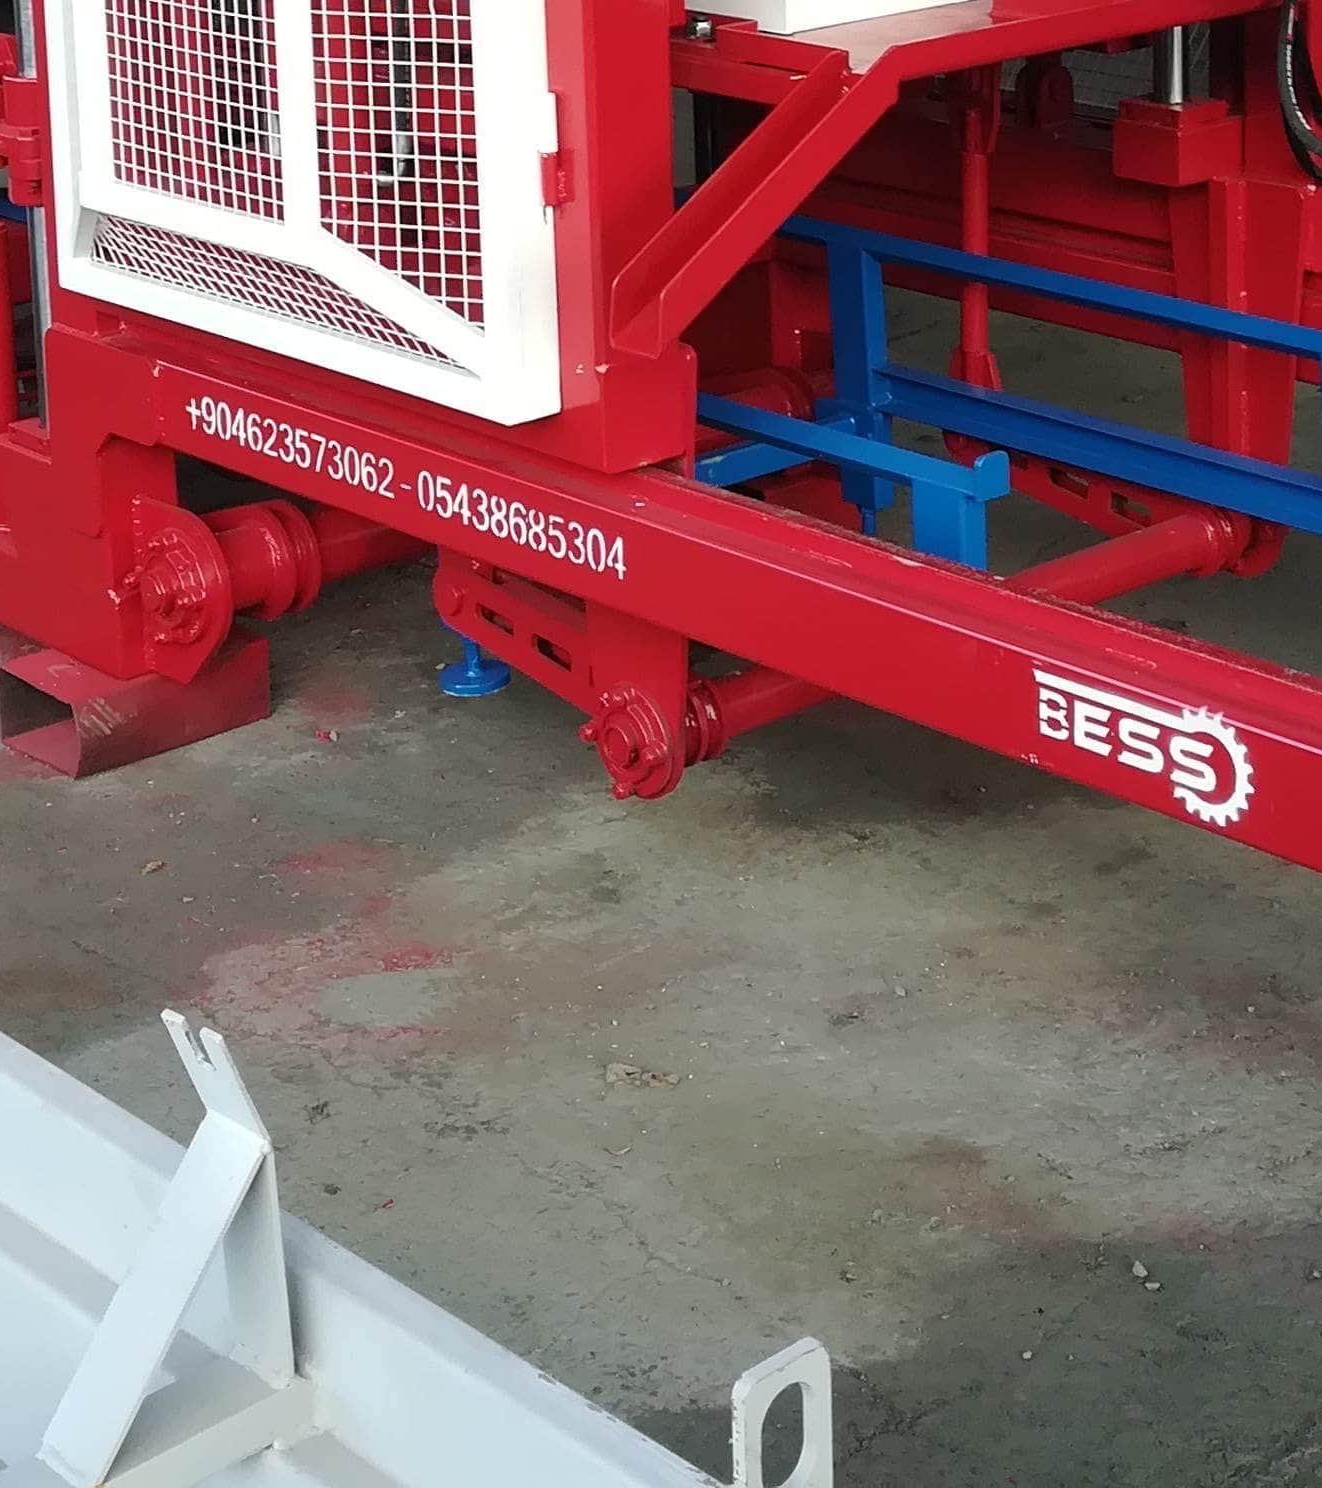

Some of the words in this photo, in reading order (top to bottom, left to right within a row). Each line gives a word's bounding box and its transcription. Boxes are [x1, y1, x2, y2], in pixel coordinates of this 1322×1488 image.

[185, 396, 396, 500] +904623573062
[416, 469, 627, 580] 05438685304
[1038, 686, 1218, 793] BESS
